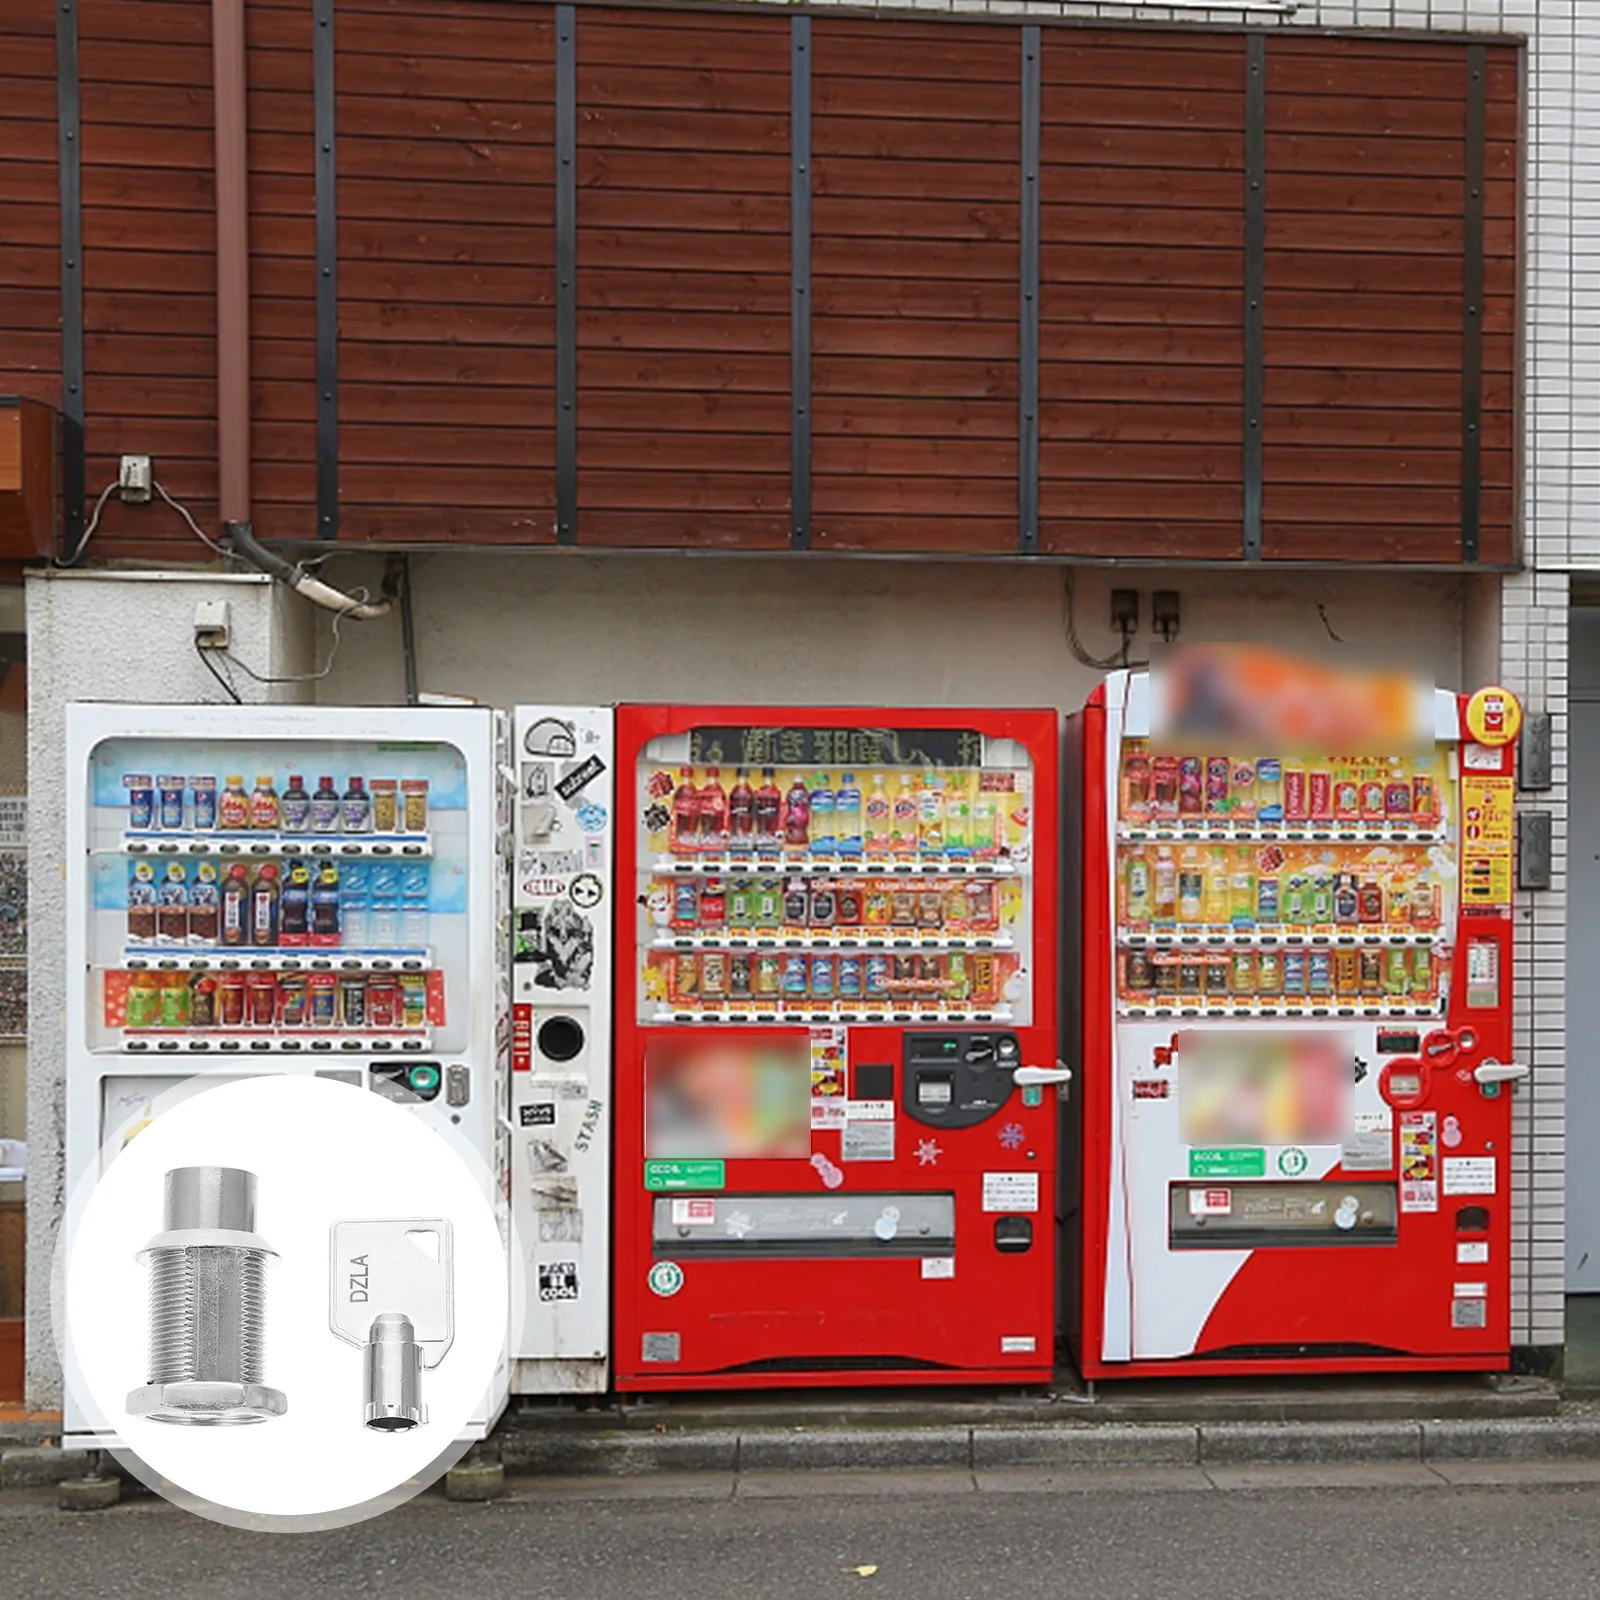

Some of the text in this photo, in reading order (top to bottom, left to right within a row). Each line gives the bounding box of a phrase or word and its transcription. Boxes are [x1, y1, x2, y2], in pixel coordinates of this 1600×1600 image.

[574, 1099, 603, 1153] STASH
[349, 1254, 369, 1303] DZLA
[541, 1285, 576, 1300] COOL
